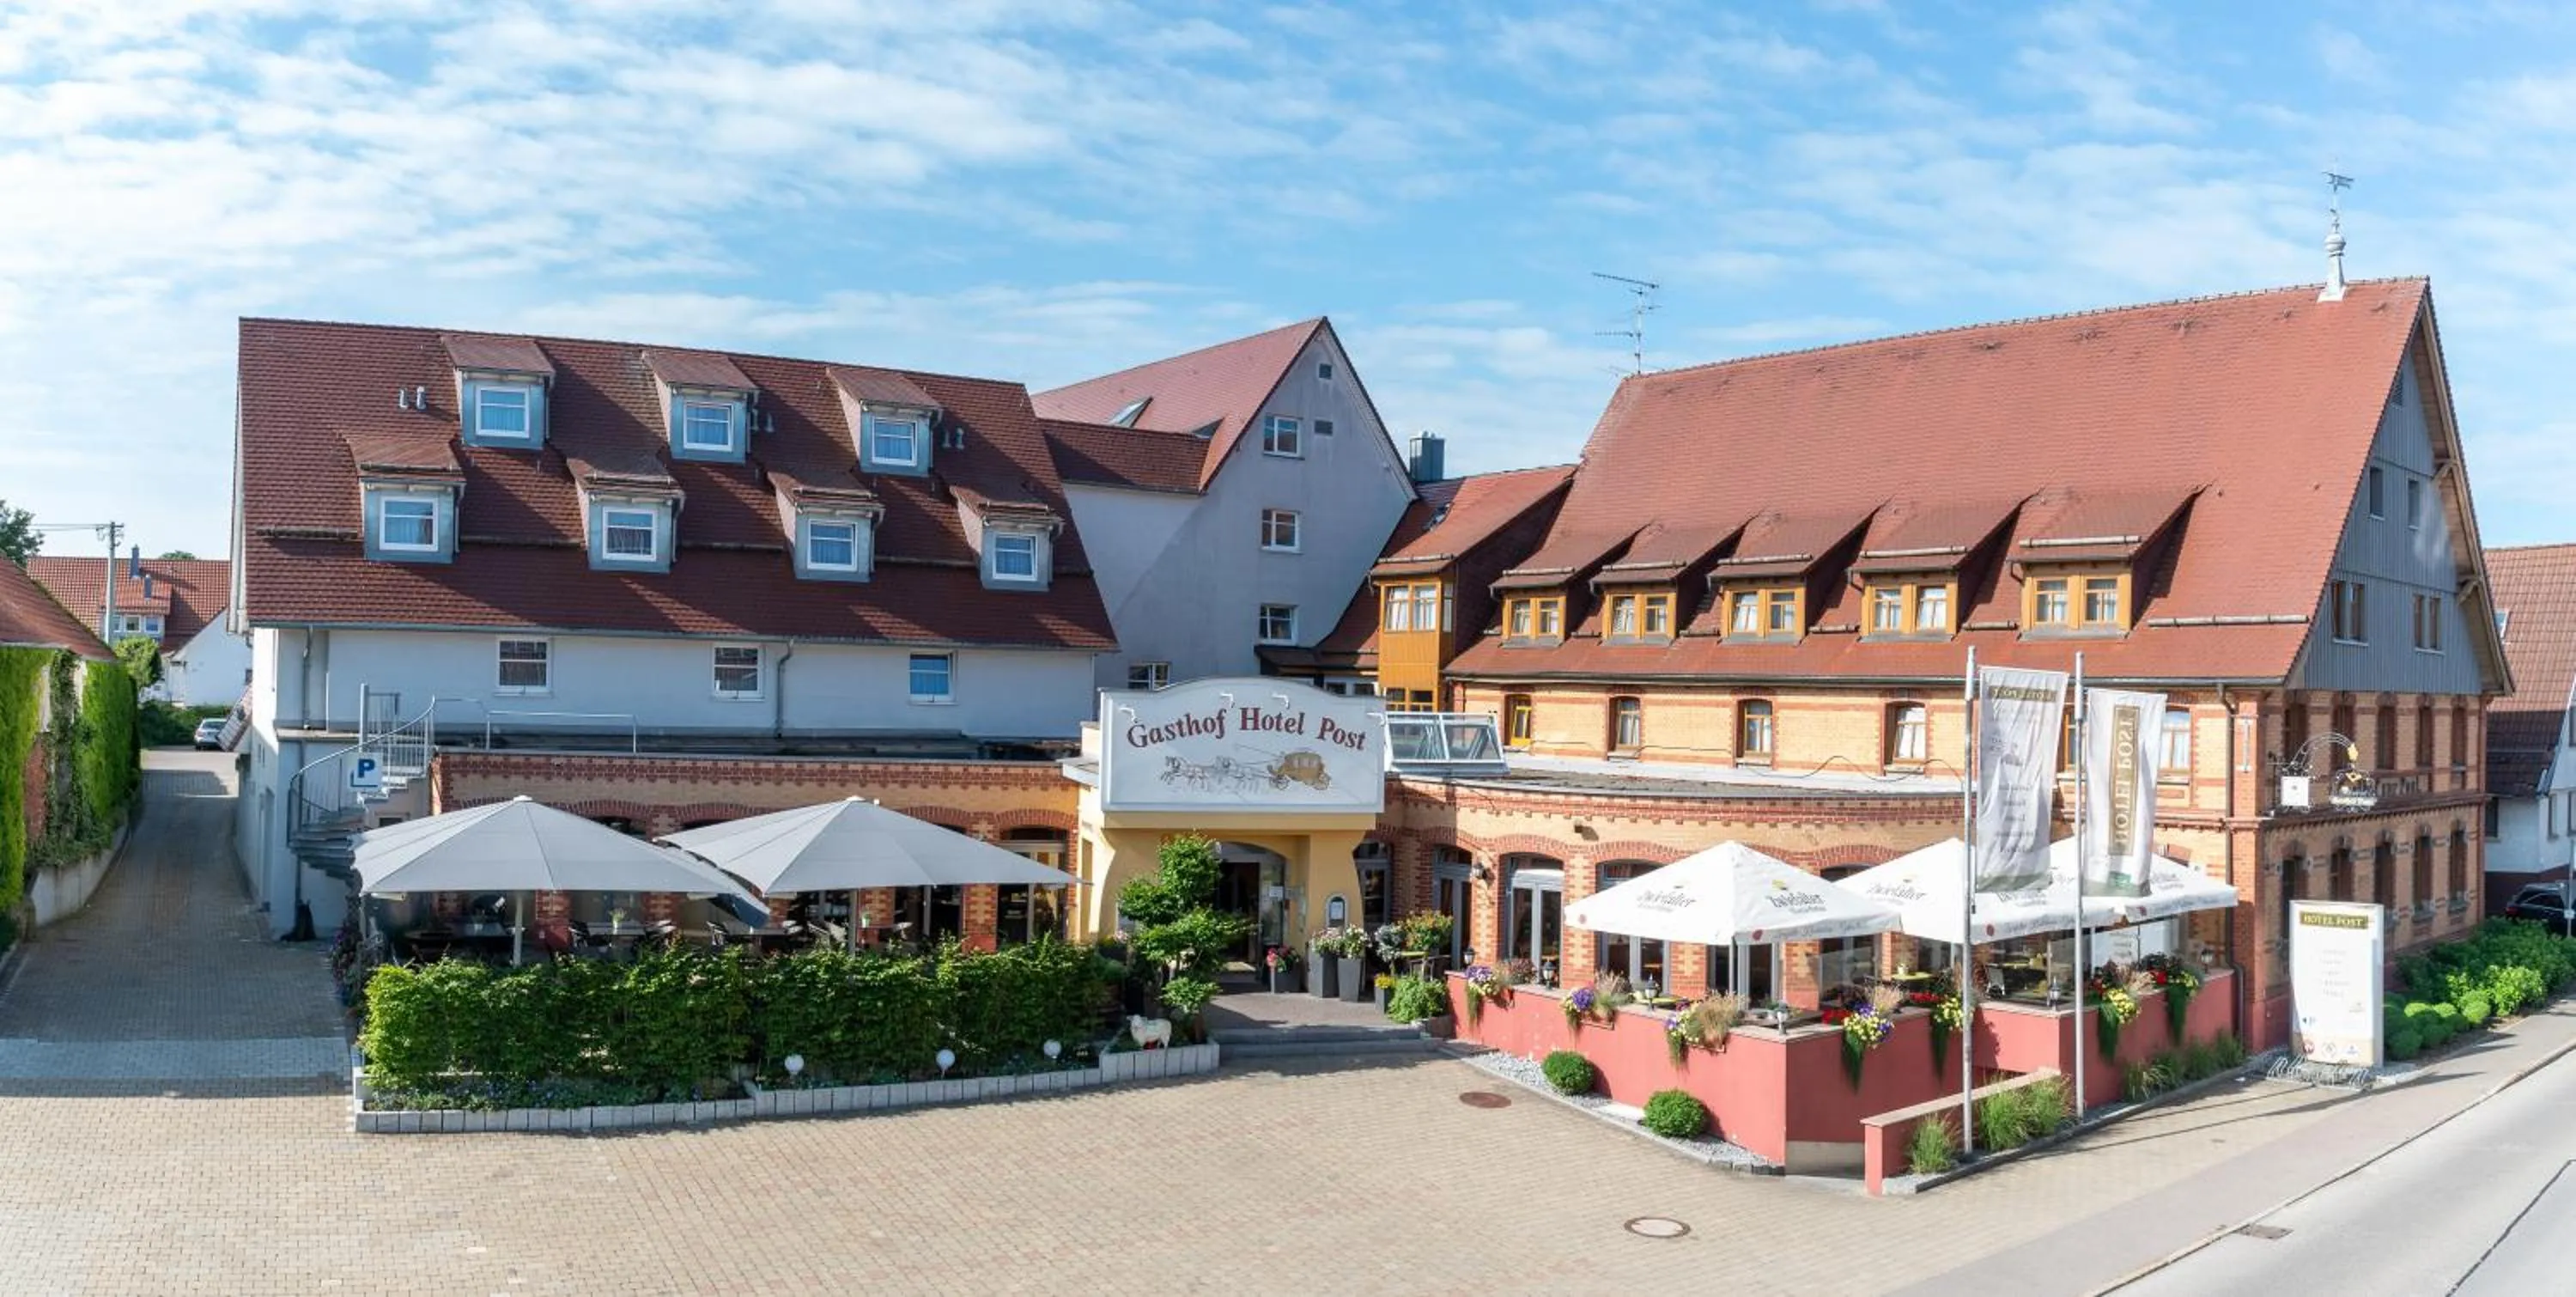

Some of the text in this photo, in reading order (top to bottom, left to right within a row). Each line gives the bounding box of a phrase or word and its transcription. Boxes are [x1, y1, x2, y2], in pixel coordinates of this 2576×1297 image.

[1127, 707, 1366, 751] Gasthof Hotel Post
[357, 758, 375, 778] P
[2304, 913, 2364, 927] HOTEL POST
